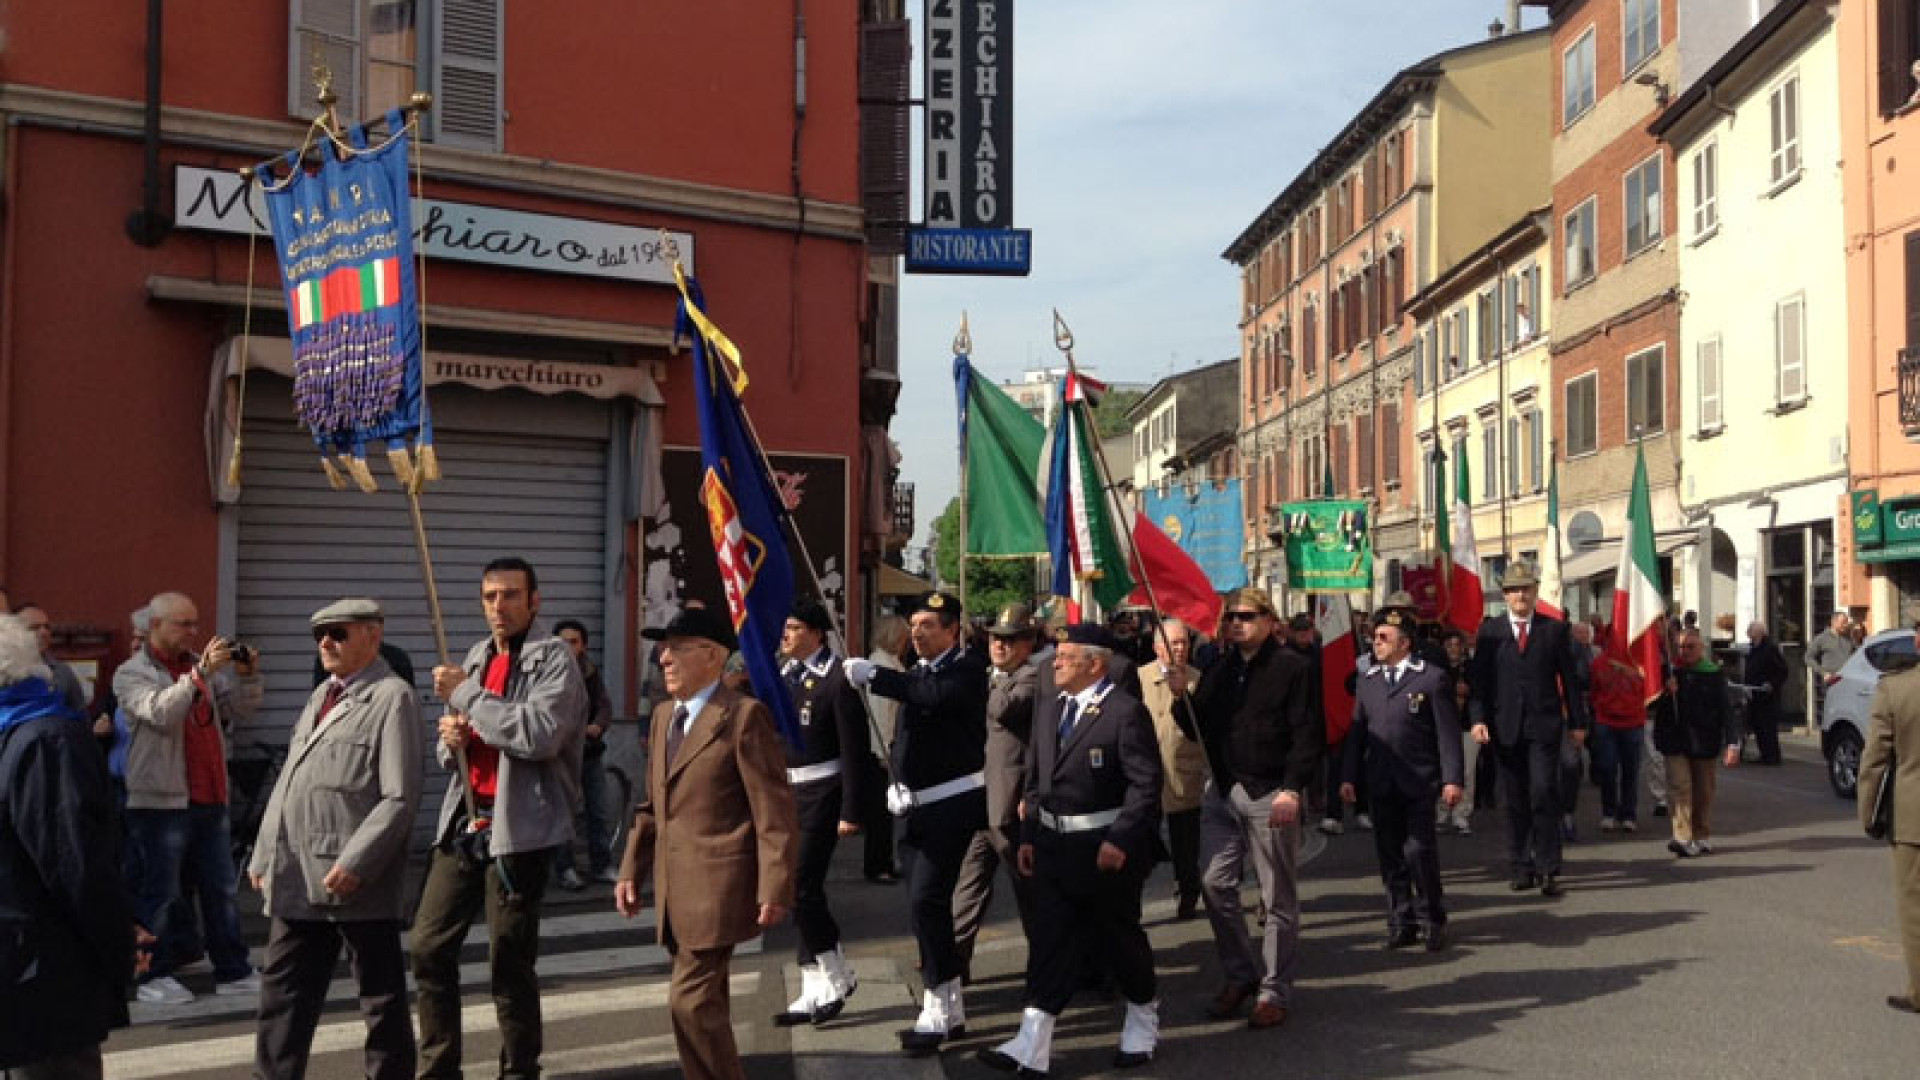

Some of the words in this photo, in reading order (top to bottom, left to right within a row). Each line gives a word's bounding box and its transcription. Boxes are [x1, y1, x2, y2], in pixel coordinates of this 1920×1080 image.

[975, 2, 998, 223] ECHIARO
[597, 244, 627, 267] dal
[911, 234, 1024, 262] RISTORANTE
